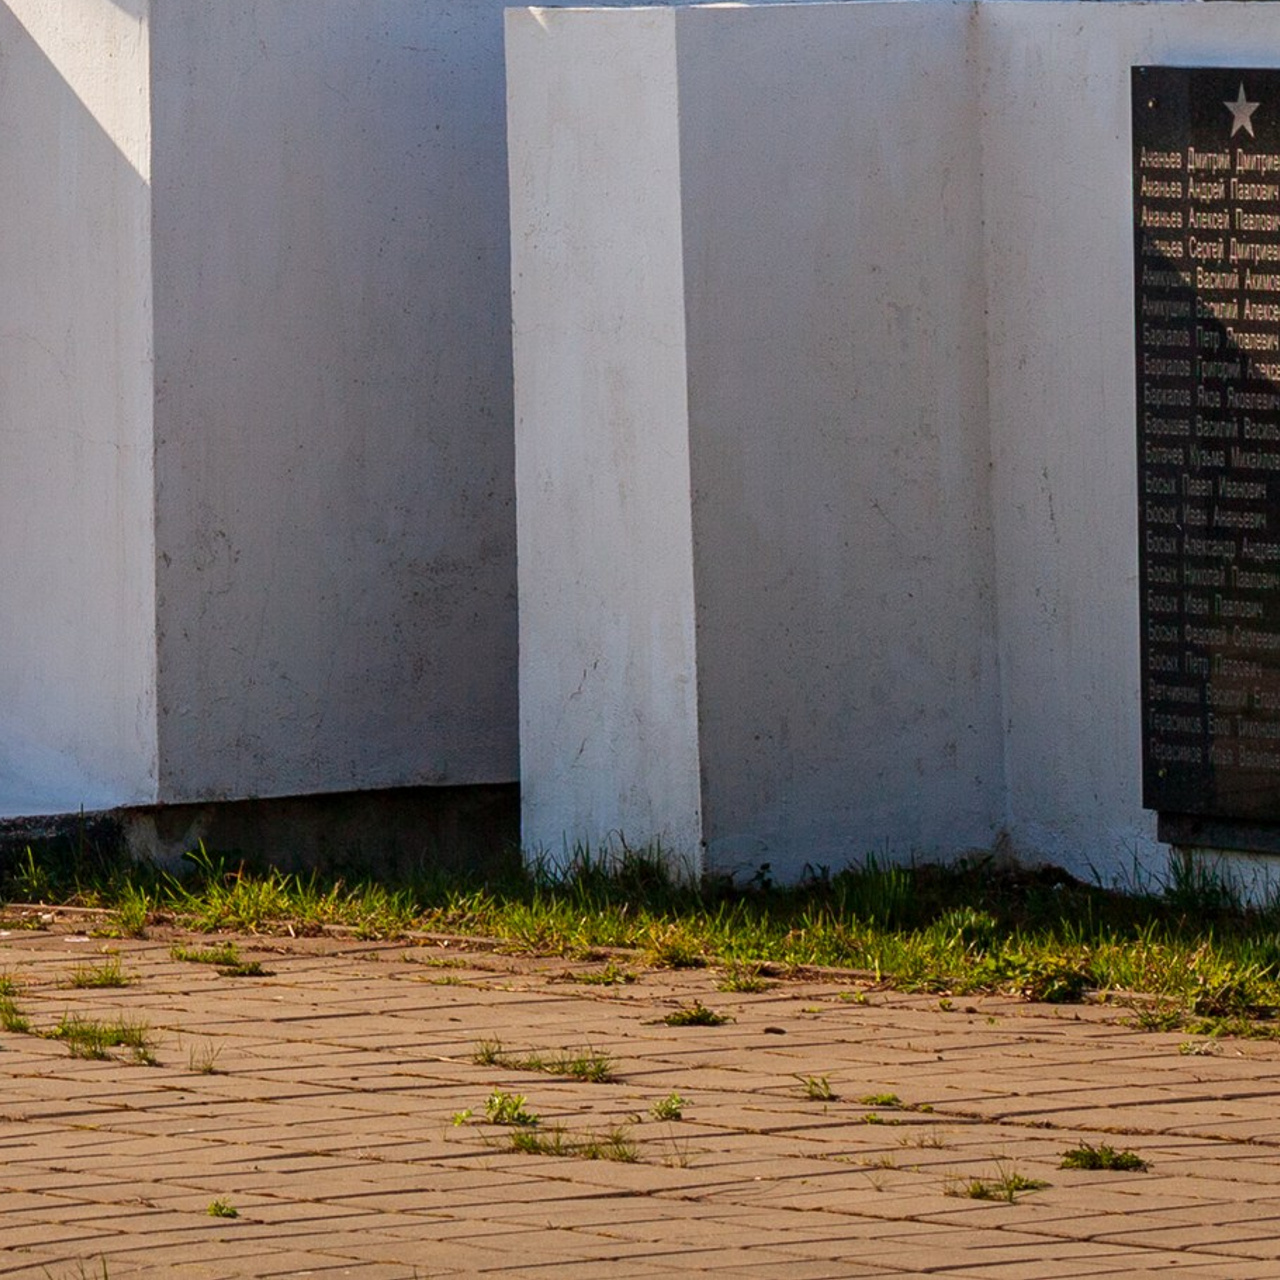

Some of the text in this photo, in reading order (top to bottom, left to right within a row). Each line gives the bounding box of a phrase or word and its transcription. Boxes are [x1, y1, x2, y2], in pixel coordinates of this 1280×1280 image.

[1140, 146, 1280, 176] Ананьев Дмитрий Дмитрие
[1140, 175, 1279, 204] Ананьев Андрей Павлович
[1140, 205, 1183, 228] Ананьев
[1188, 207, 1230, 230] Алексей
[1141, 235, 1184, 258] Ананьев
[1189, 236, 1225, 264] Сергей
[1196, 266, 1239, 289] Василий
[1196, 296, 1238, 319] Василий
[1243, 298, 1280, 321] Алексе
[1196, 326, 1220, 353] Петр
[1196, 355, 1240, 382] Григорий
[1197, 385, 1221, 407] Яков
[1196, 415, 1238, 437] Василий
